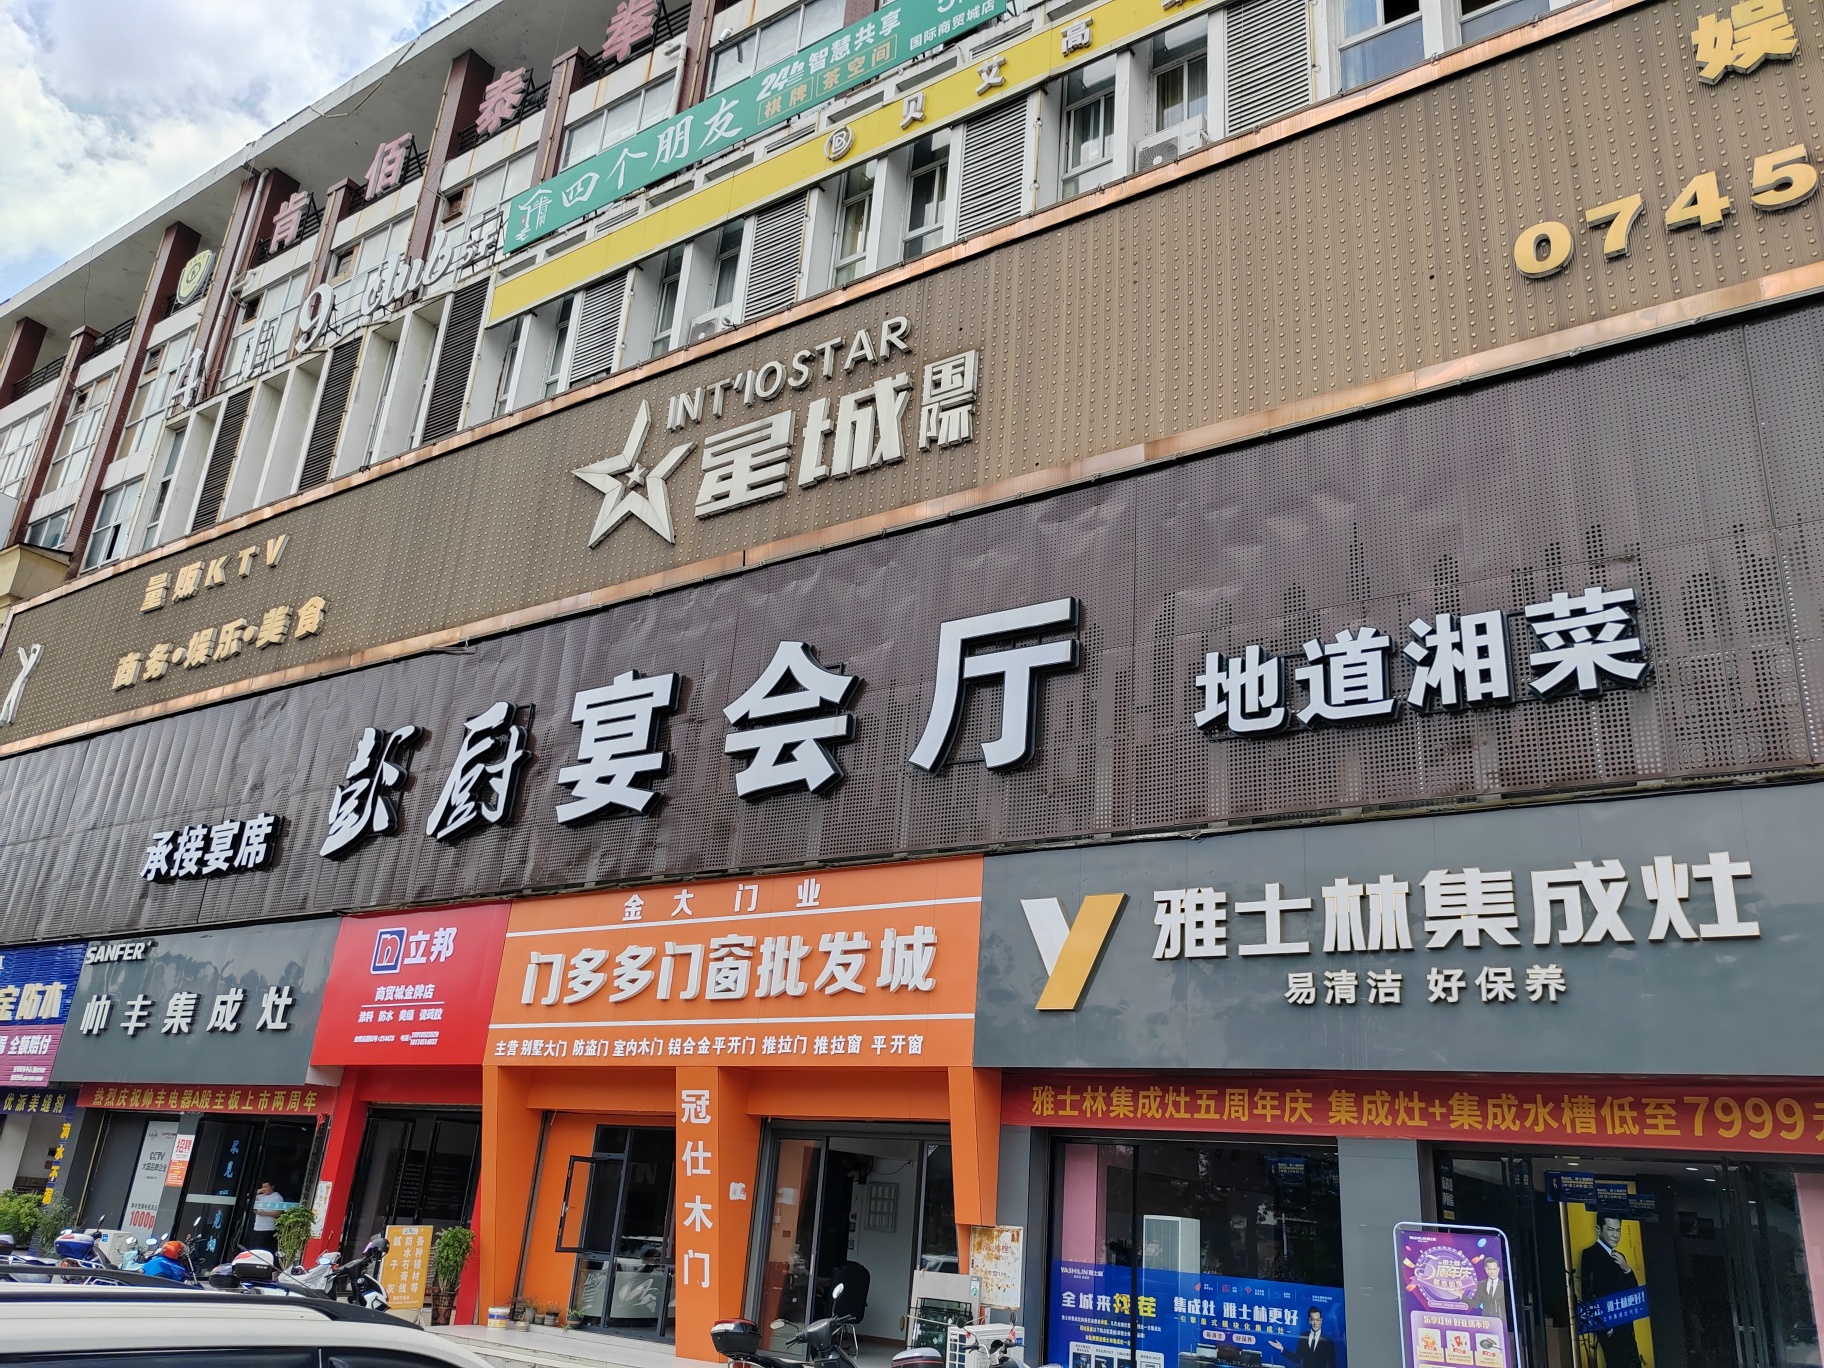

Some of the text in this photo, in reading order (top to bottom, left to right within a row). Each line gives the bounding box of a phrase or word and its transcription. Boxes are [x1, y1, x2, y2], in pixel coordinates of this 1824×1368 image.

[910, 0, 994, 51] 国际商贸城店
[1691, 0, 1799, 85] 娱
[756, 8, 901, 101] 24h 智慧共享
[822, 41, 891, 90] 茶空间
[764, 84, 808, 118] 棋牌
[562, 98, 742, 208] 四个朋友
[1514, 144, 1818, 278] 0745
[361, 230, 454, 316] club
[1193, 587, 1656, 738] 地道湘菜
[140, 812, 277, 881] 承接宴席
[622, 878, 821, 922] 金大门业
[1152, 851, 1761, 960] 雅士林集成灶
[85, 940, 151, 964] SANFER
[404, 927, 457, 965] 立邦
[521, 926, 938, 1006] 门多多门窗批发城
[375, 984, 435, 1001] 商贸城金牌店
[1284, 964, 1567, 1006] 易清洁 好保养
[79, 985, 294, 1036] 帅丰集成灶
[8, 1034, 52, 1055] 全额赔付
[494, 1034, 924, 1058] 主营 别墅大门 防盗门 室内木门 铝合金平开门 推拉门 推拉窗 平开窗
[3, 1093, 66, 1114] 优派美缝剂
[92, 1087, 318, 1110] 热烈庆祝帅丰电器A股主板上市两周年
[1031, 1085, 1313, 1125] 雅士林集成灶五周年庆
[175, 1138, 193, 1153] 招聘
[681, 1089, 713, 1288] 冠仕木门
[1173, 1296, 1299, 1326] 集成灶 雅士林更好
